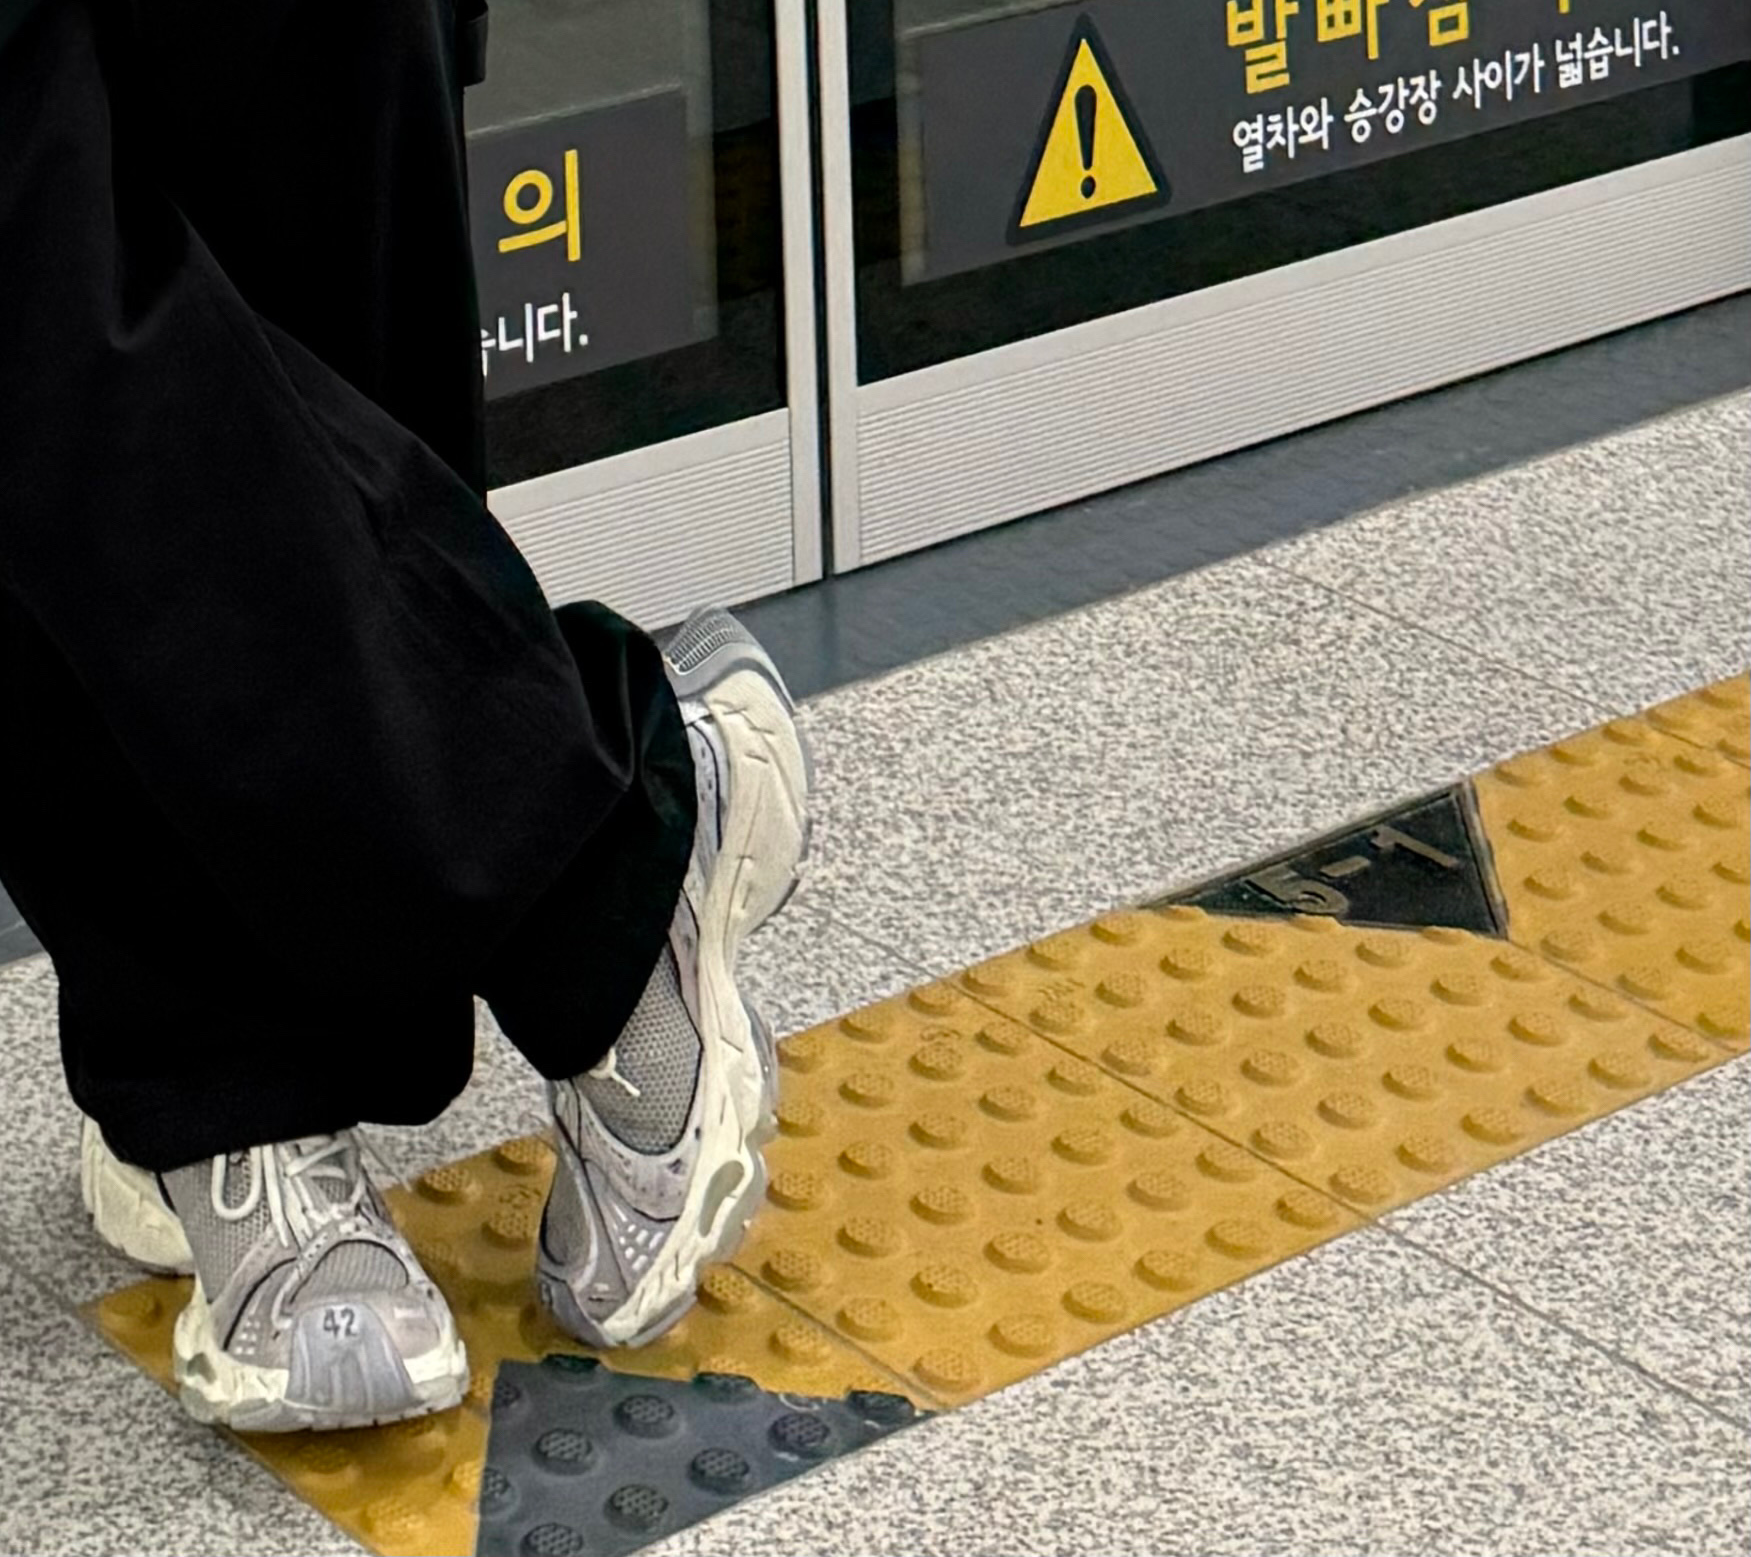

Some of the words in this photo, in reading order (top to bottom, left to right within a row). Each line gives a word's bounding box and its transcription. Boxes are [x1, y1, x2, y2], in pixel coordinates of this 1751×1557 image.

[1231, 98, 1333, 173] 열차와
[1343, 69, 1441, 142] 승강장
[1452, 42, 1546, 110] 사이가
[1554, 11, 1680, 89] 넓습니다.
[498, 148, 581, 262] 의
[323, 1306, 358, 1339] 42
